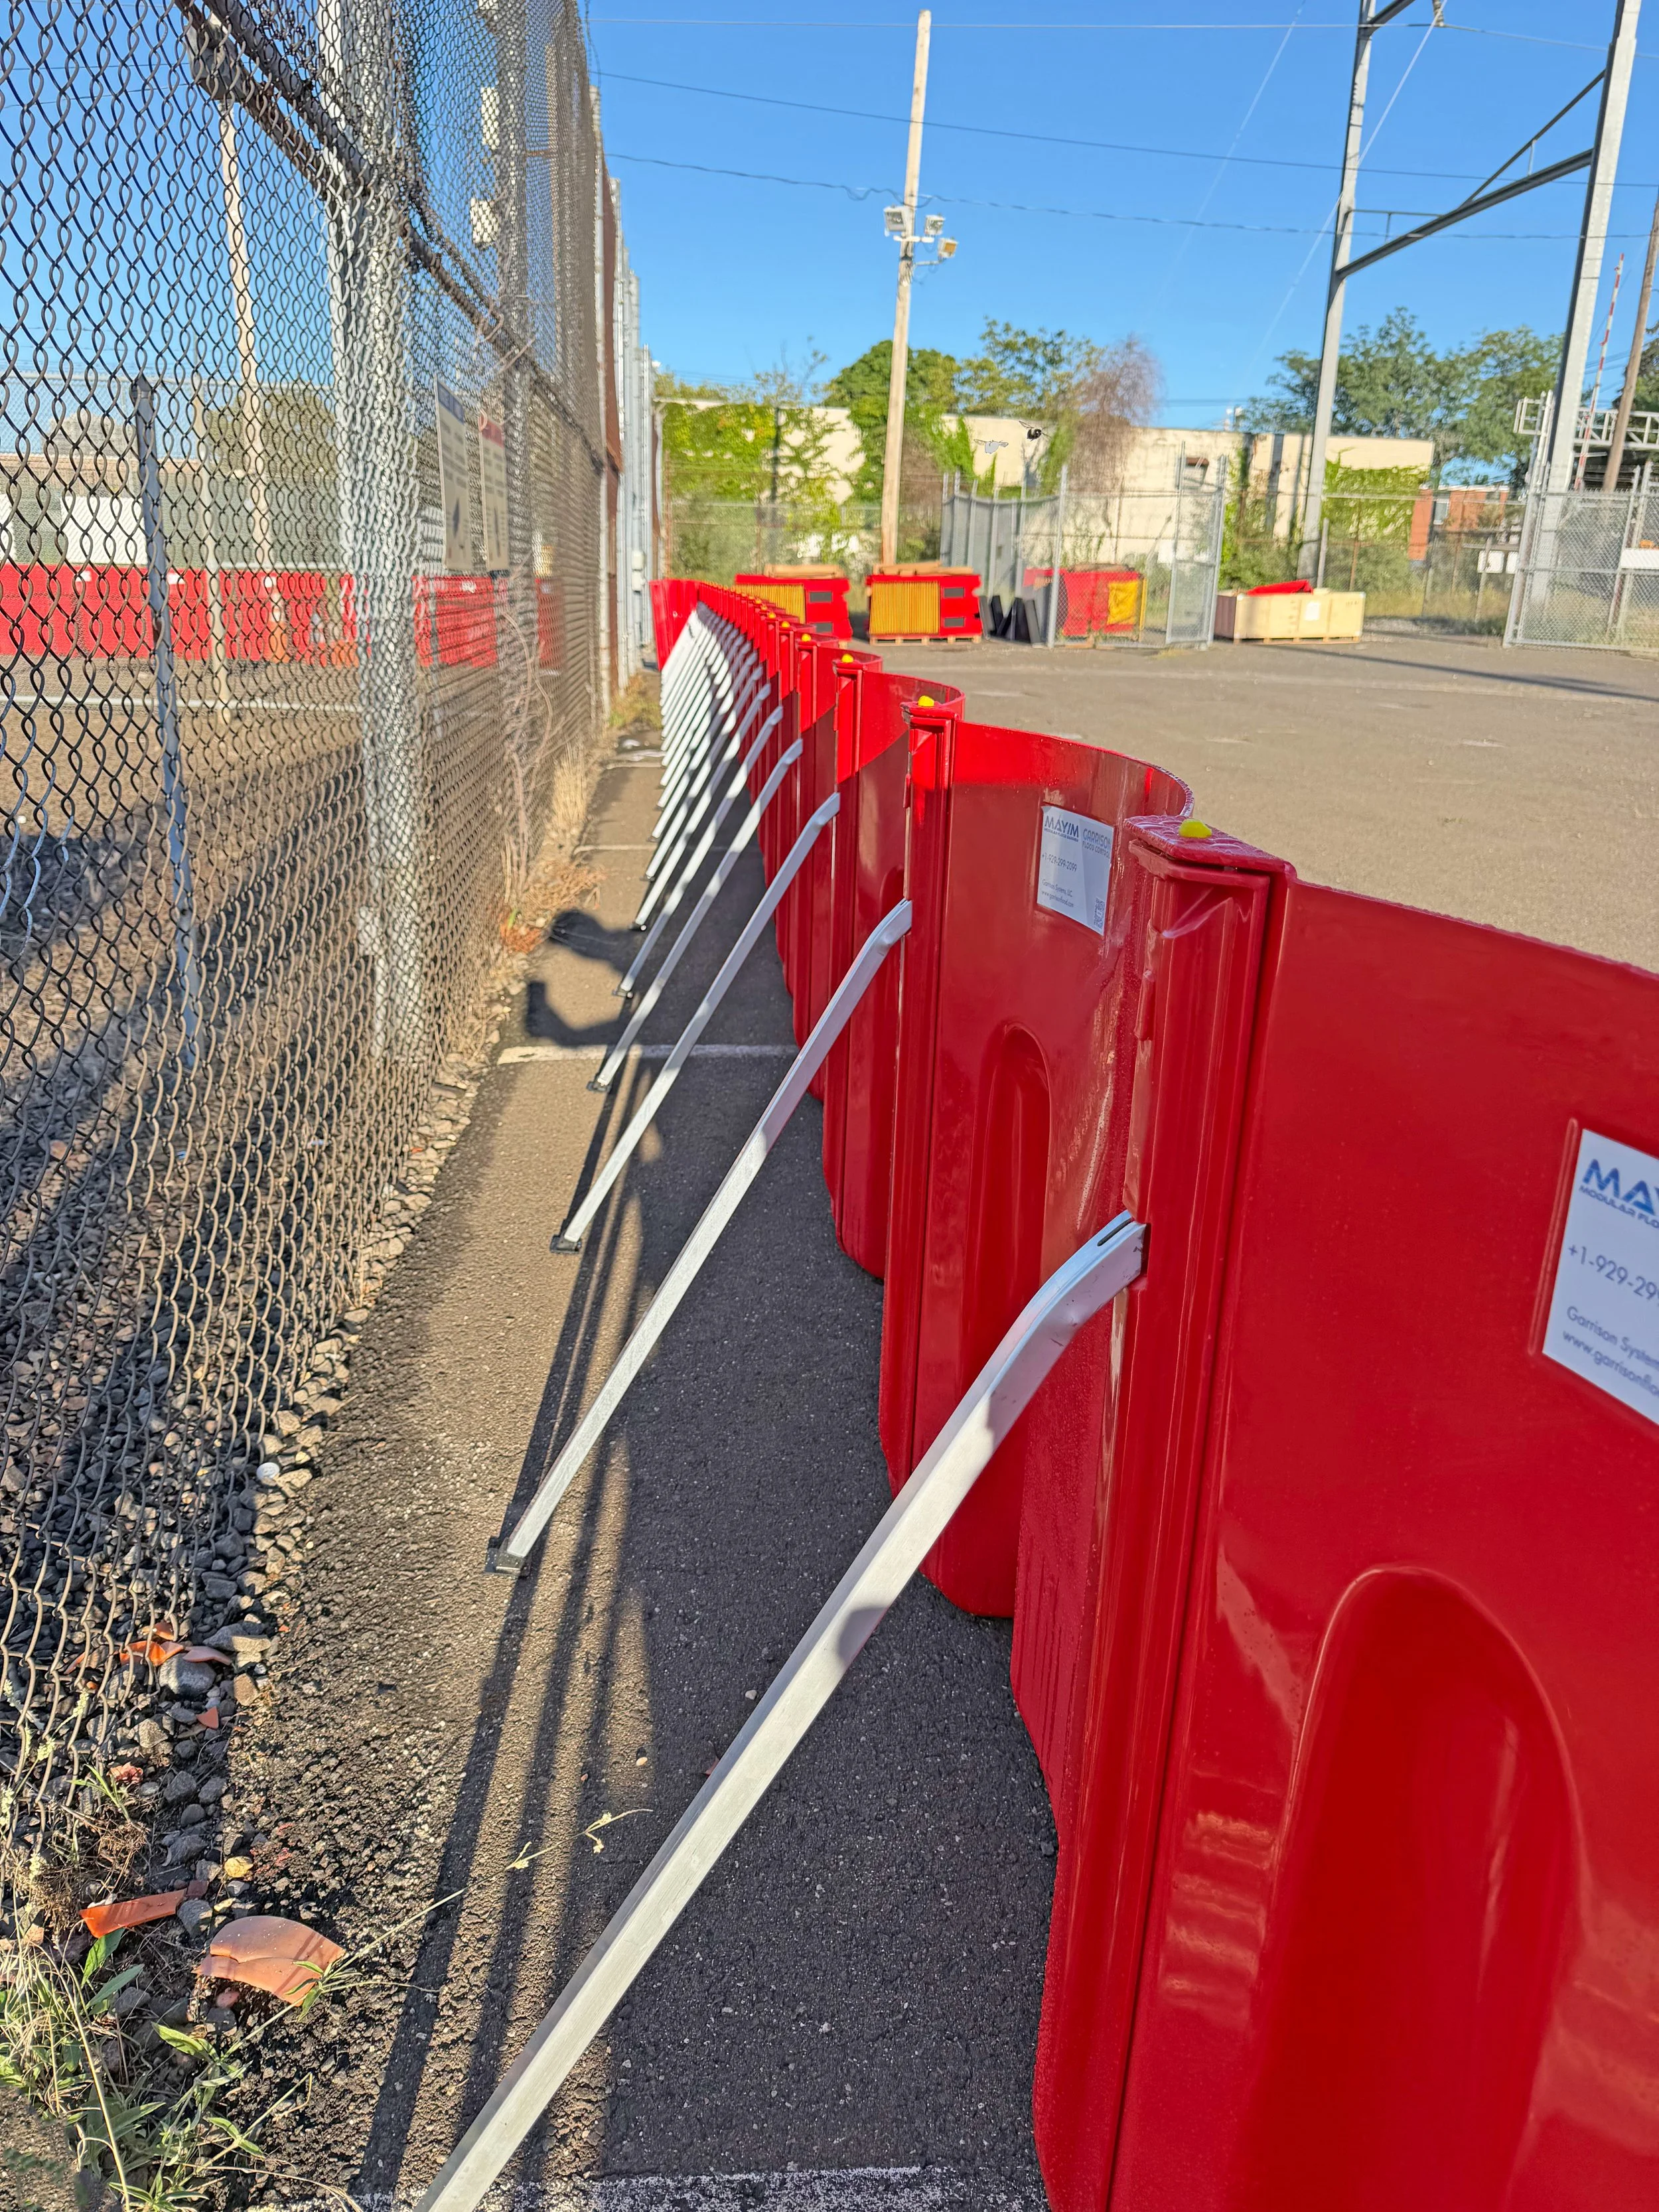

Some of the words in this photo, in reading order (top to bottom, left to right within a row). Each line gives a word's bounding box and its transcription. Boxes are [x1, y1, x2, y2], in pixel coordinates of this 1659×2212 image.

[1045, 816, 1078, 838] MAYIM
[1579, 1185, 1635, 1218] MODULAR
[1583, 1159, 1659, 1216] MA
[1569, 1245, 1659, 1307] +1-929-29
[1567, 1306, 1617, 1345] Garrison
